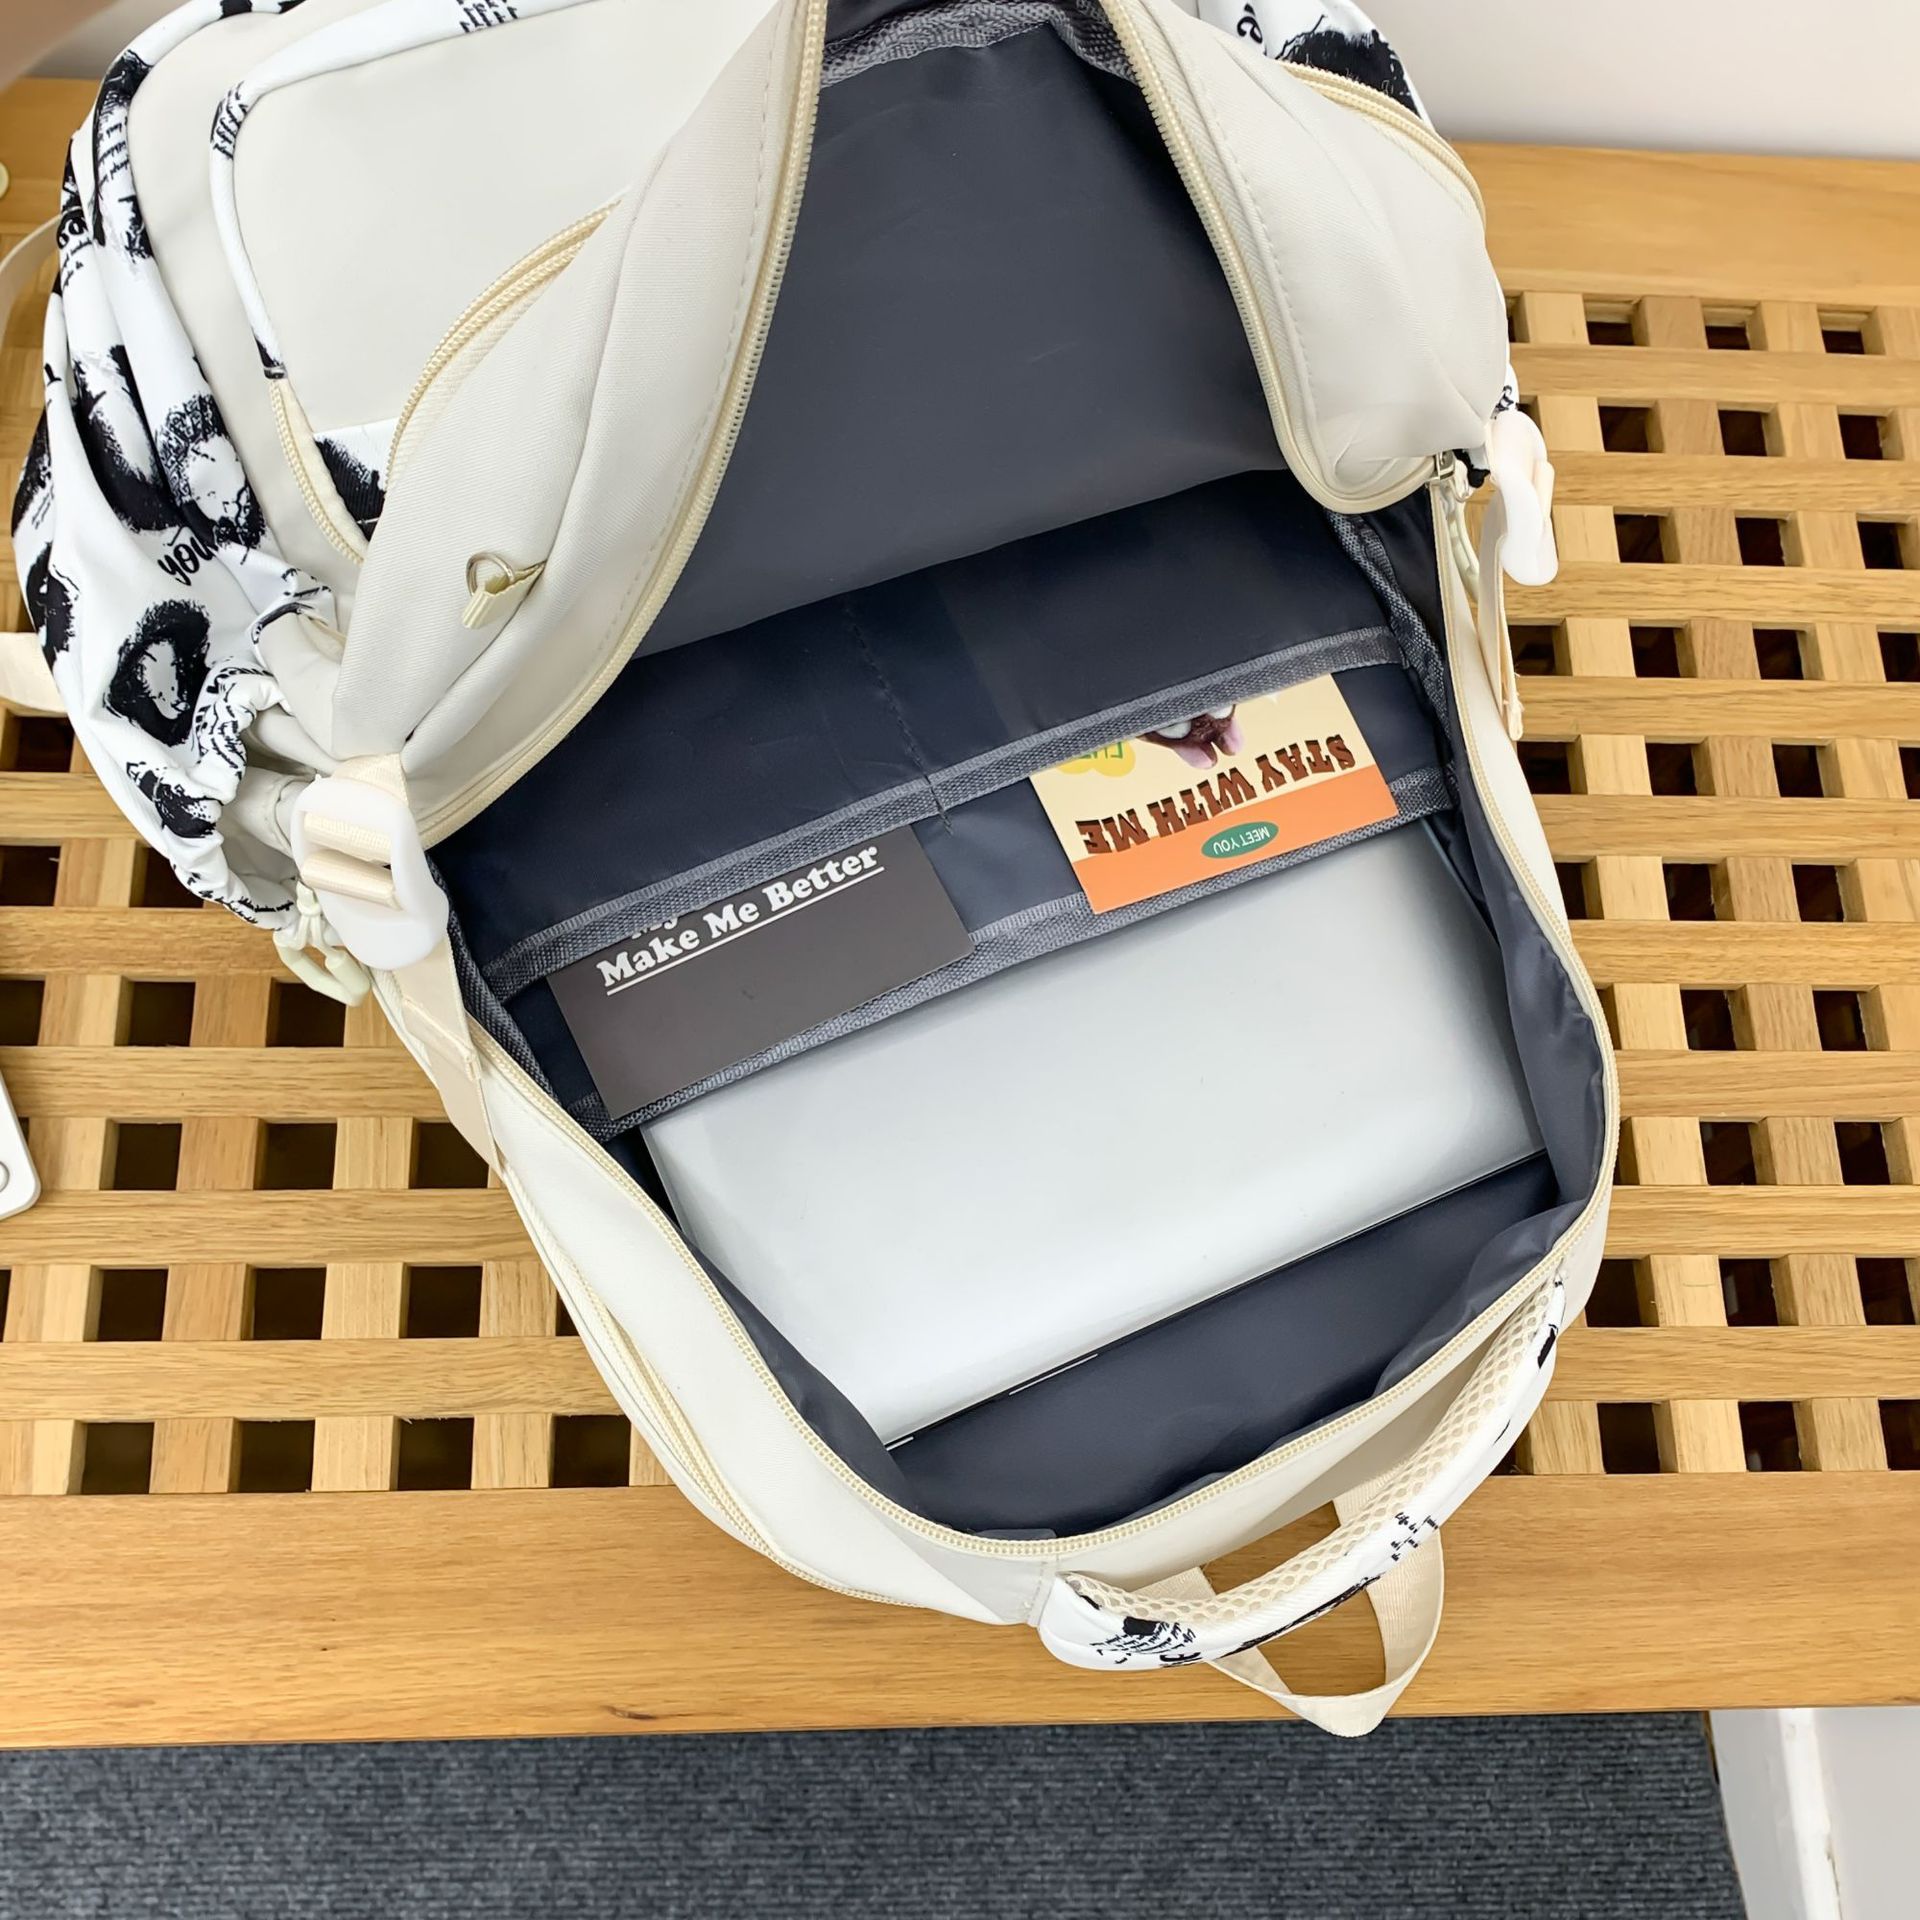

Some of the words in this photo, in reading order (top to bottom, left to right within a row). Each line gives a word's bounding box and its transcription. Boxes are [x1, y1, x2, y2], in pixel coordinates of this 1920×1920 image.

[1255, 734, 1355, 793] STAY
[1146, 767, 1257, 838] WITH
[1075, 808, 1151, 853] ME
[1213, 837, 1240, 854] YOU
[1239, 826, 1270, 847] MEET
[596, 928, 700, 987] Make
[703, 903, 760, 939] Me
[762, 846, 879, 913] Better
